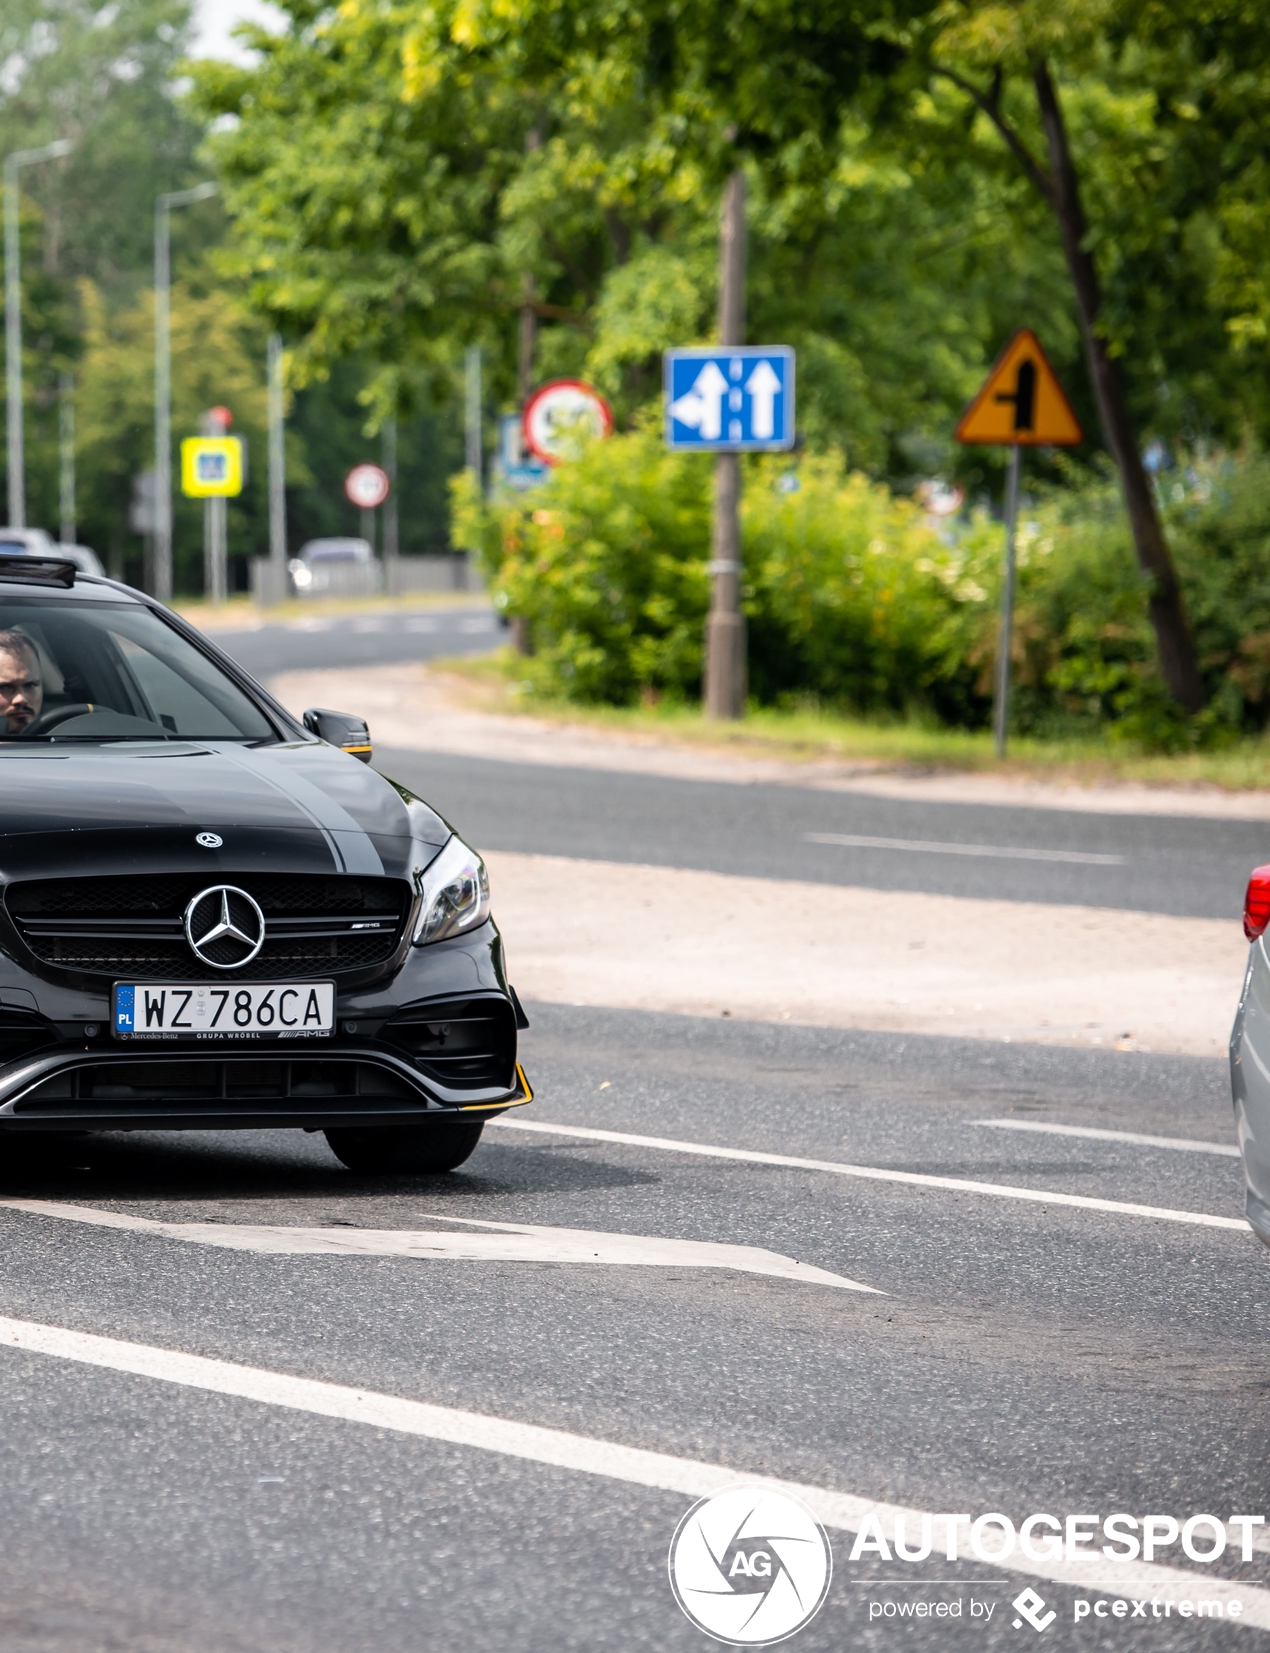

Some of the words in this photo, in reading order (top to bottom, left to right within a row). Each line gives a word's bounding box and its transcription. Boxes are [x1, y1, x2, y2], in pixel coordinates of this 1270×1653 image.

[144, 990, 193, 1028] WZ
[210, 988, 322, 1027] 786CA
[118, 1014, 132, 1025] PL
[130, 1032, 179, 1040] Mercedes-Benz
[227, 1031, 261, 1039] WRÓBEL
